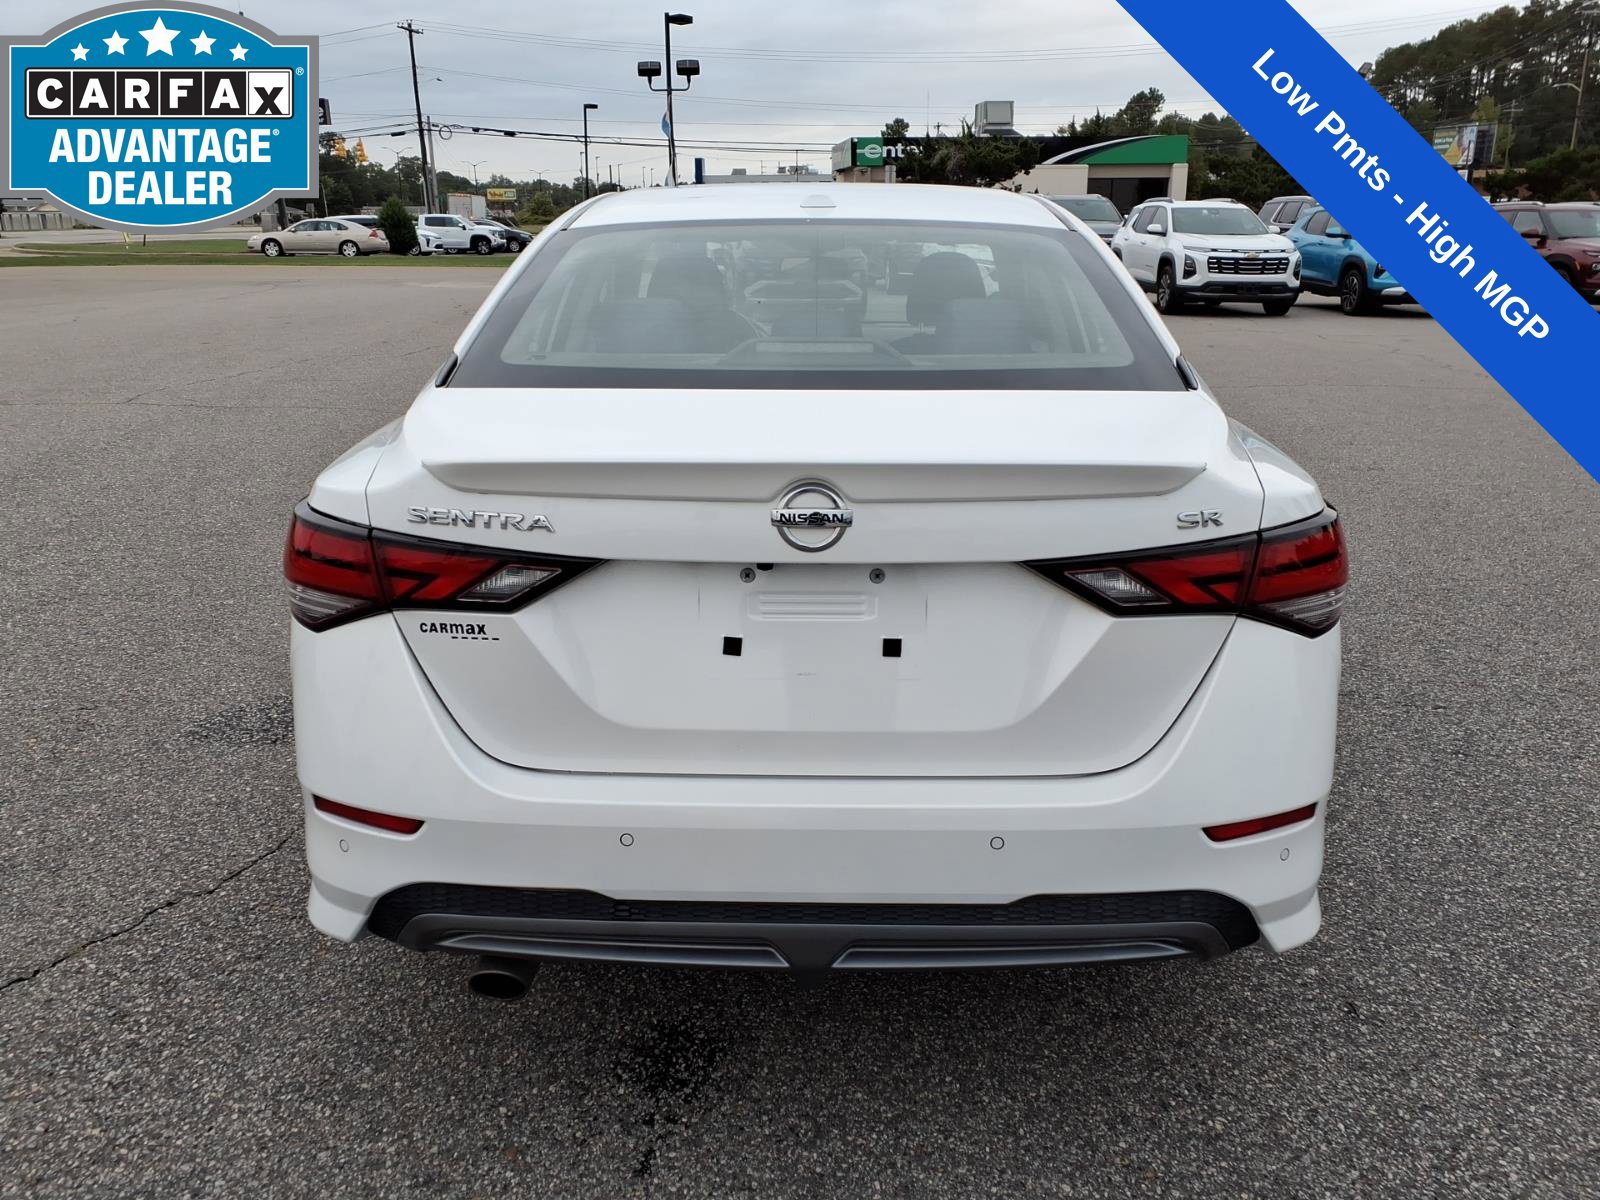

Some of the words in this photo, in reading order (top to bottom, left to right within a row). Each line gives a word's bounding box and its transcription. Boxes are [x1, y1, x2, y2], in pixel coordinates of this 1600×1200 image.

[408, 506, 556, 533] SENTRA
[779, 512, 844, 524] NISSAN
[1177, 510, 1224, 530] SR
